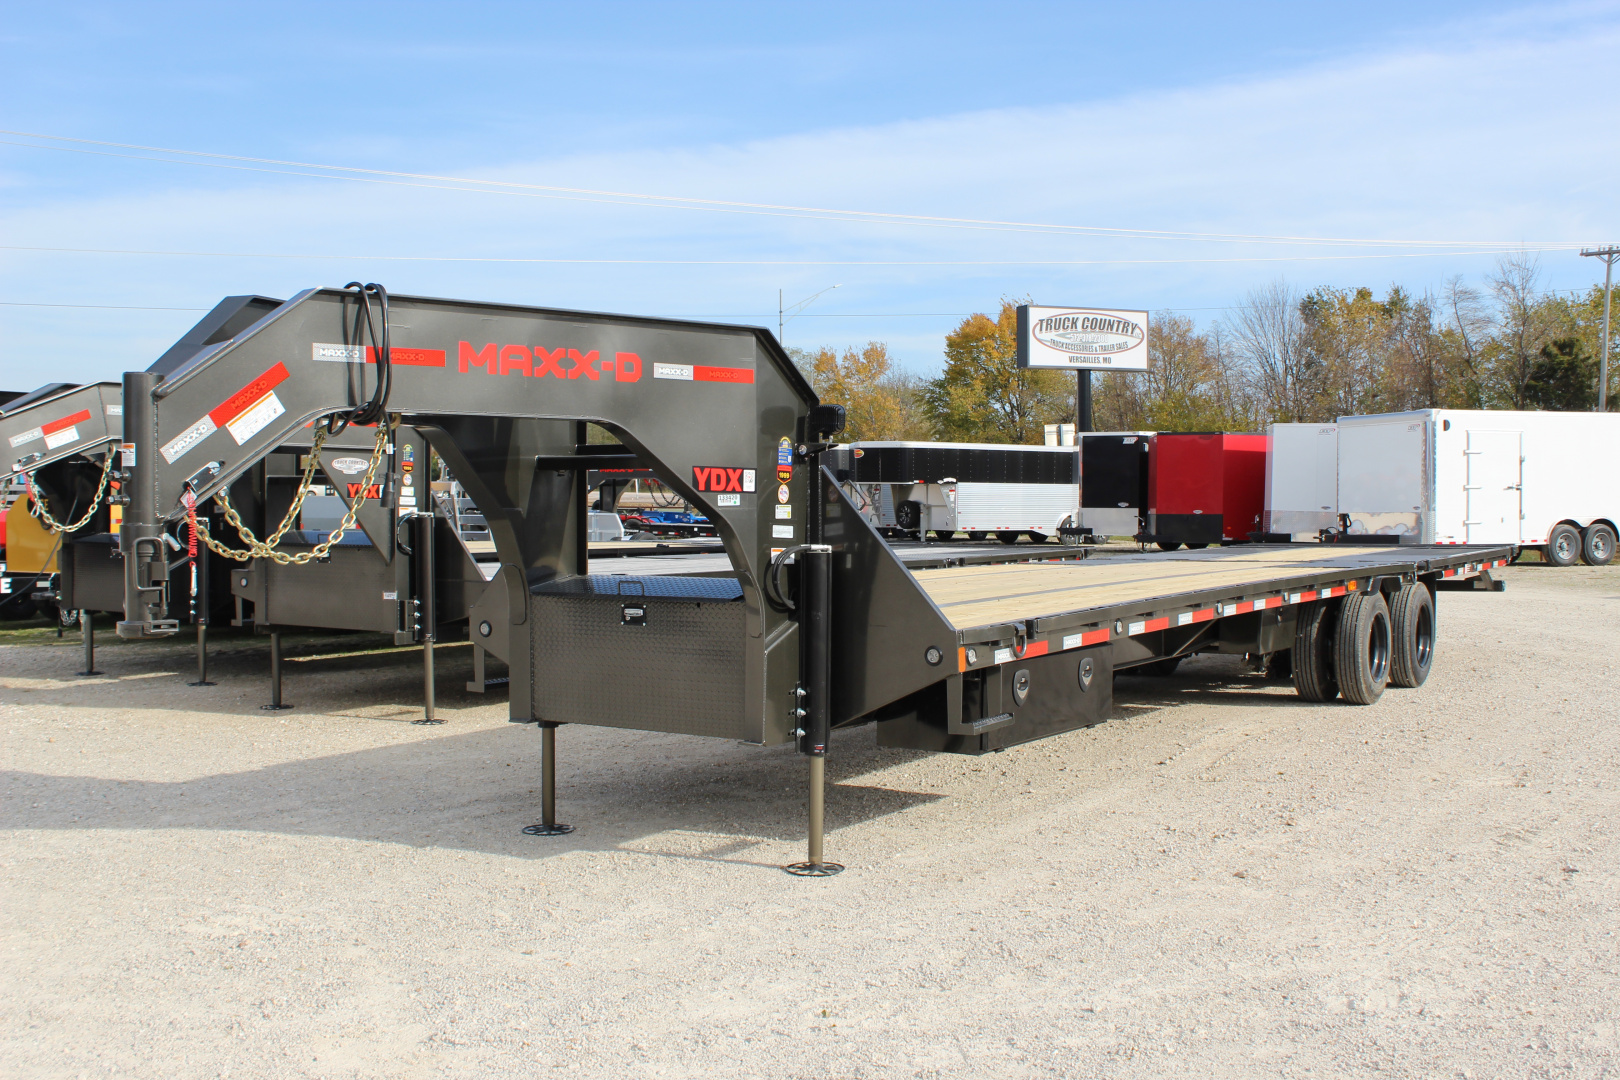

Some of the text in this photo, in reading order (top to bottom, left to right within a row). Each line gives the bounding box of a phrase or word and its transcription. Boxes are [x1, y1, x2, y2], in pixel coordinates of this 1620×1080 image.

[1038, 316, 1138, 335] TRUCK COUNTRY
[320, 348, 360, 358] MAXX-D
[1050, 339, 1064, 348] TRUCK
[1065, 342, 1094, 352] ACCESSORIES
[1099, 344, 1115, 352] TRAILER
[1115, 341, 1128, 349] SALES
[458, 340, 642, 383] MAXX-D
[1102, 356, 1111, 364] MO
[659, 367, 689, 376] MAXX-D
[230, 380, 268, 410] MAXX-D
[168, 424, 209, 456] MAXX-D
[693, 467, 743, 492] YDX
